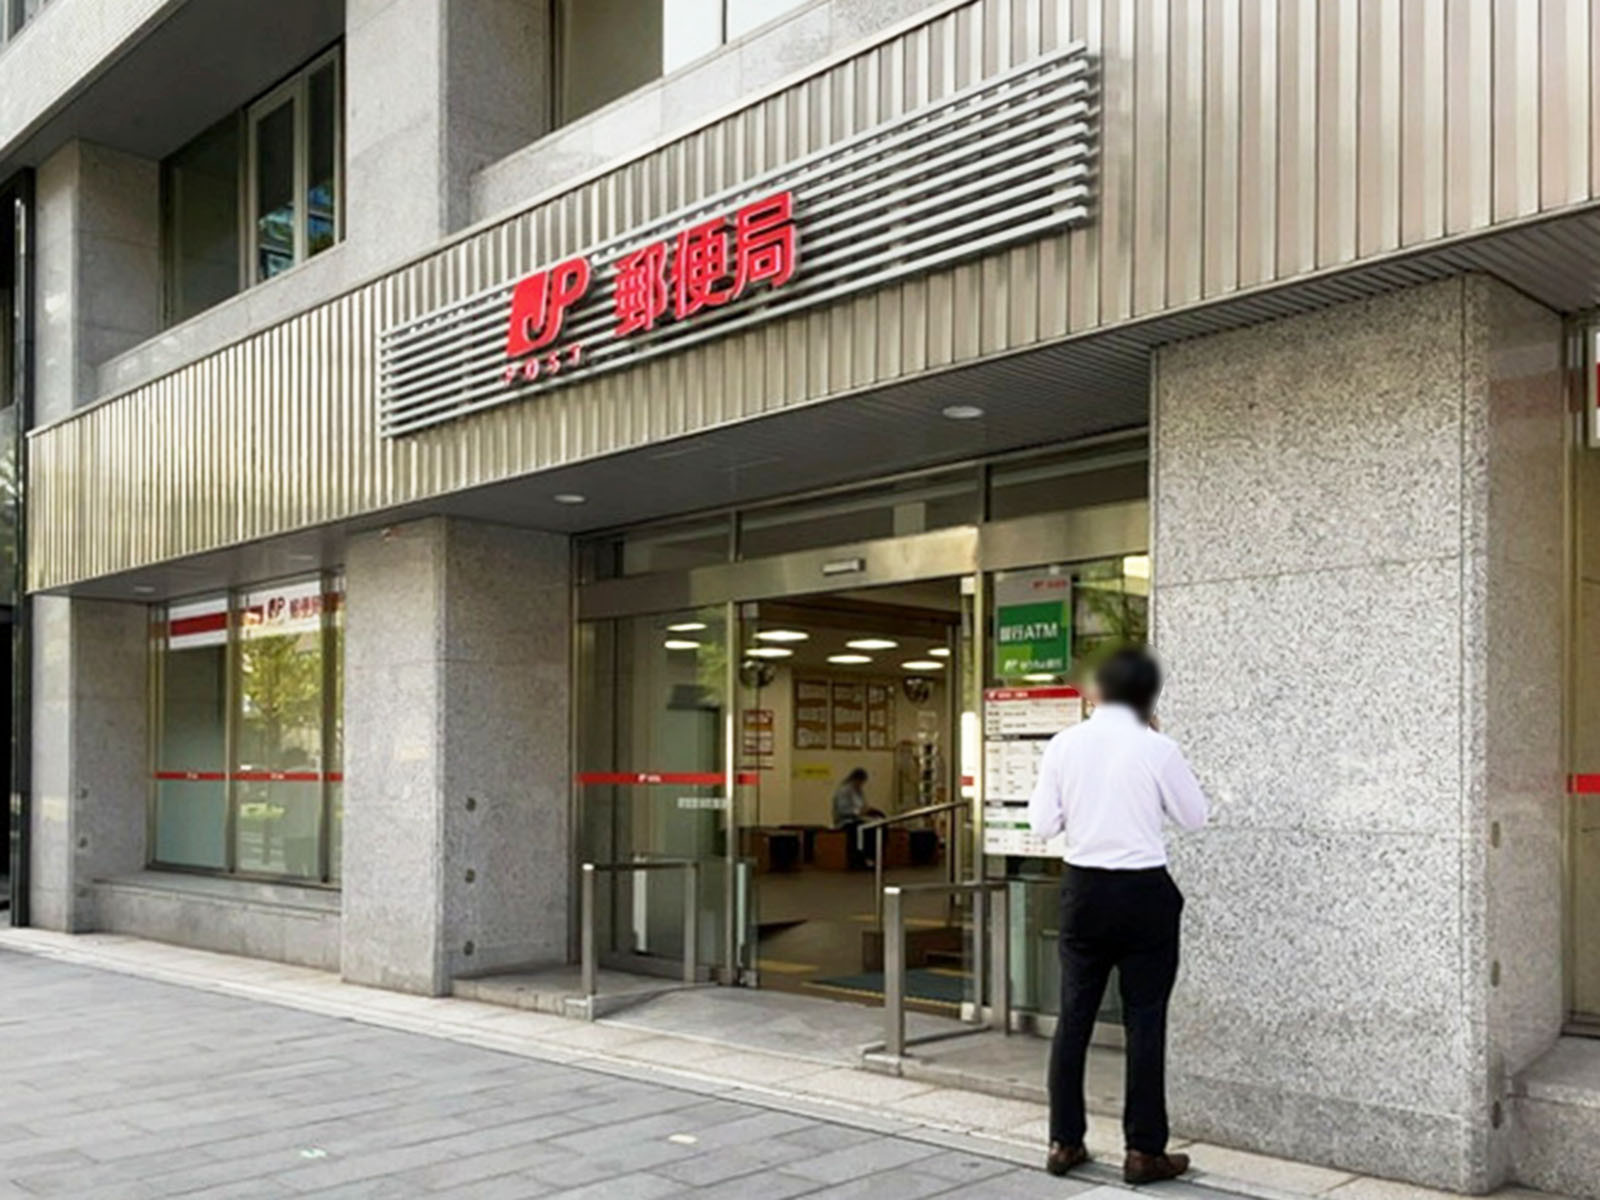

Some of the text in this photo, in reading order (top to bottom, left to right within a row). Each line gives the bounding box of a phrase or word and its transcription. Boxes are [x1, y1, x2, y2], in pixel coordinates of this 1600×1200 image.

[507, 257, 591, 357] JP
[613, 191, 797, 337] 郵便局
[501, 345, 581, 386] POST
